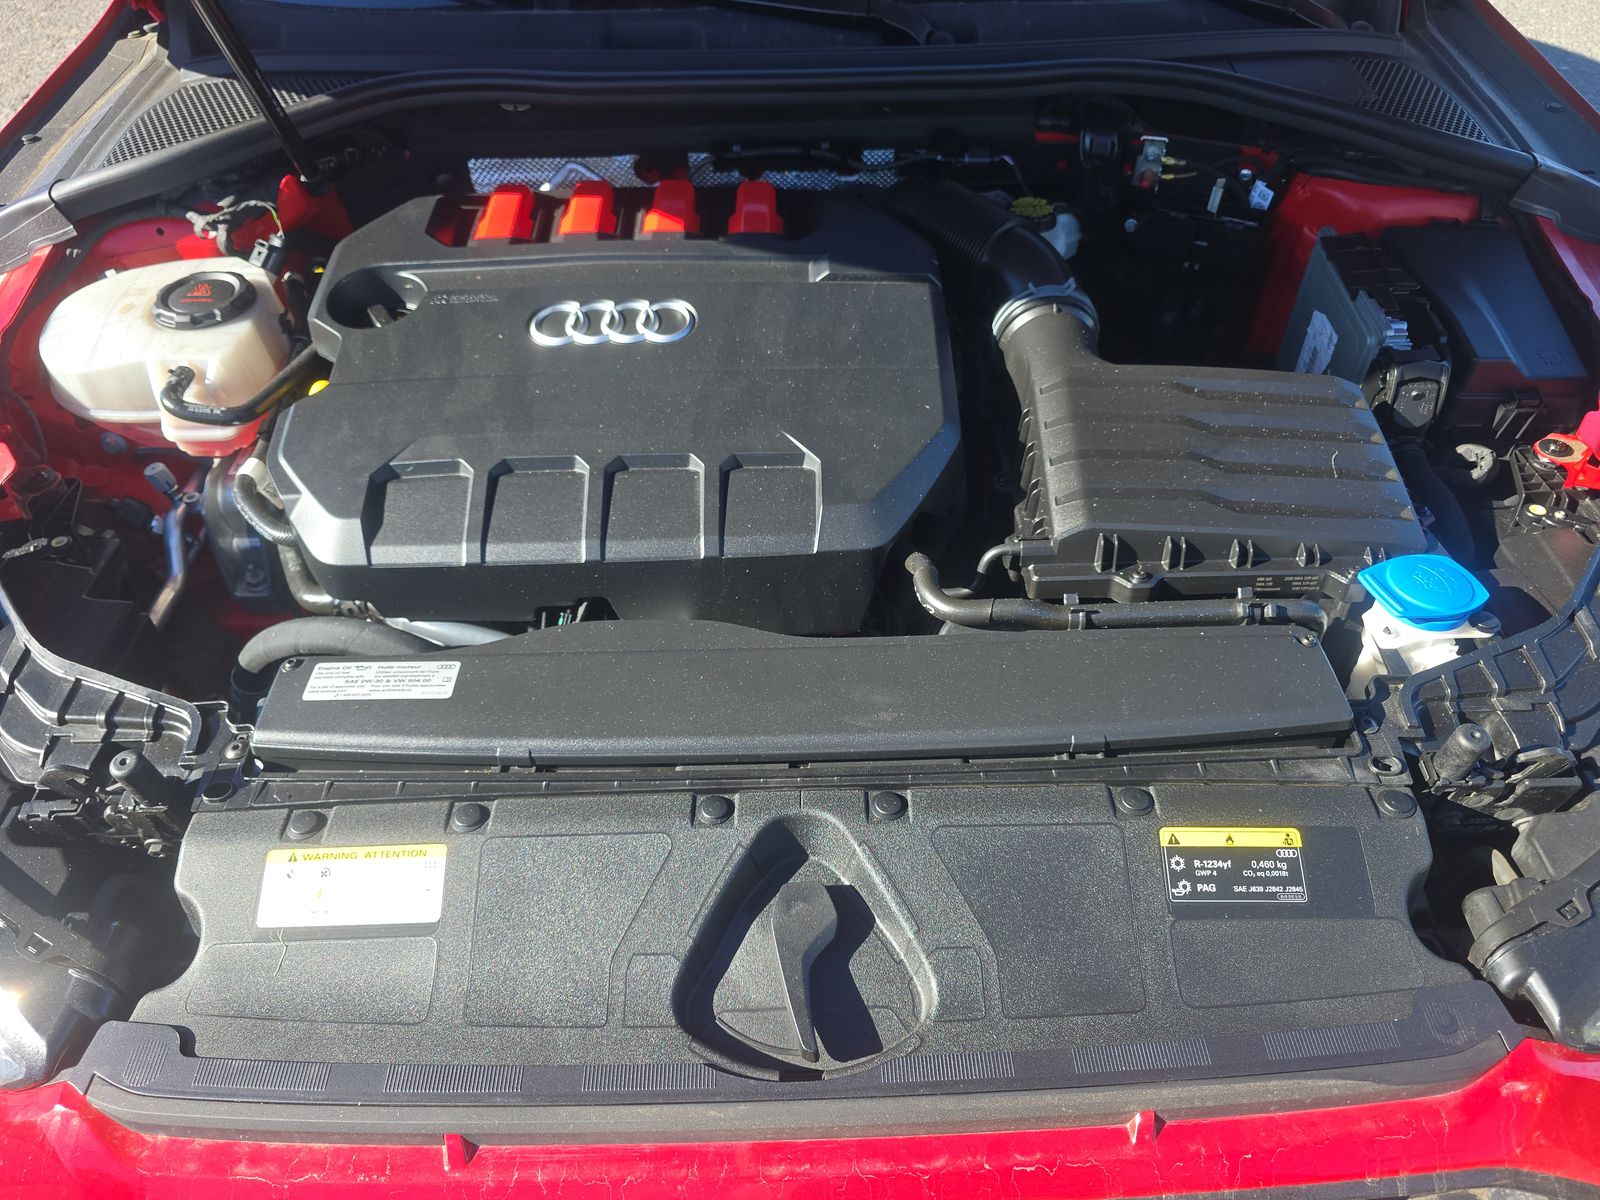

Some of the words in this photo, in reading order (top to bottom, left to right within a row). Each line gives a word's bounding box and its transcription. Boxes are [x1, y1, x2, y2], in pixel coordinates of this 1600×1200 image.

[302, 852, 358, 861] WARNING
[364, 849, 428, 859] ATTENTION
[1193, 860, 1231, 870] R-1234yf
[1251, 860, 1275, 869] 0,460
[1276, 860, 1287, 870] kg
[1196, 883, 1216, 892] PAG
